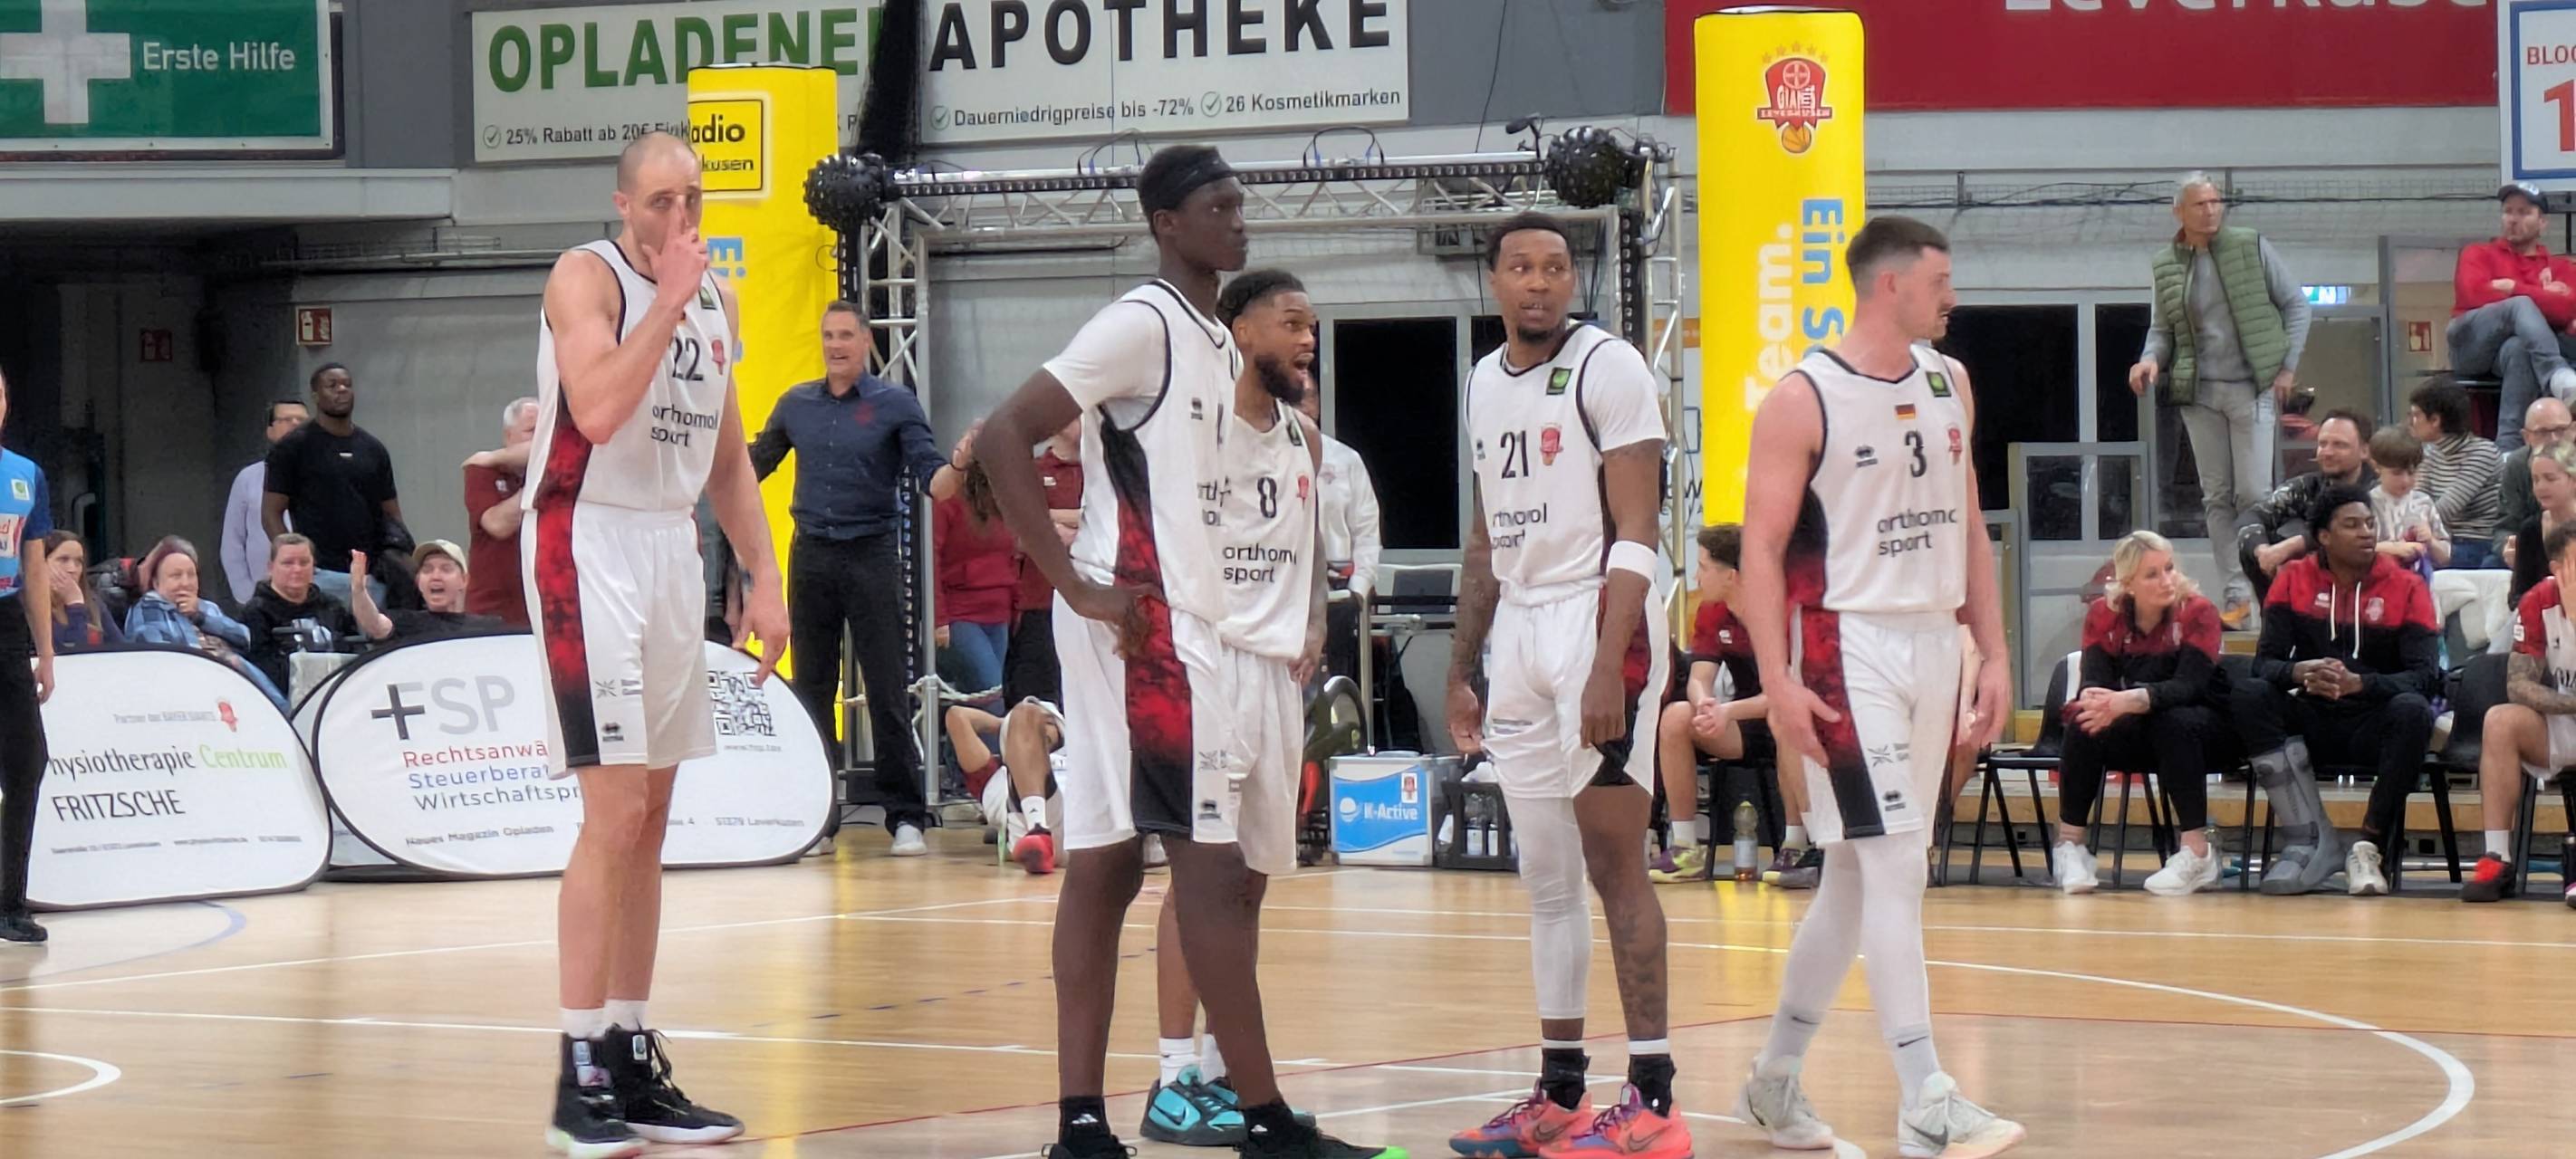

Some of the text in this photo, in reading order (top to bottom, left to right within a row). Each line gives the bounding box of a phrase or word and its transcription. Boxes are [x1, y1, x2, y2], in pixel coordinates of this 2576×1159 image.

[928, 0, 1389, 72] APOTHEKE
[142, 41, 296, 72] Erste Hilfe
[954, 89, 1401, 128] Dauerniedrigpreise bis -72% 26 Kosmetikmarken
[505, 128, 538, 146] 25%
[543, 126, 593, 143] Rabatt
[598, 124, 617, 142] ab
[1802, 197, 1846, 285] Ein
[1499, 430, 1530, 479] 21
[1904, 429, 1927, 478] 3
[1256, 476, 1278, 519] 8
[1222, 542, 1298, 565] orthom
[1878, 531, 1933, 558] sport
[1223, 564, 1275, 585] sport
[198, 743, 289, 770] Centrum
[51, 789, 187, 822] FRITZSCHE
[1363, 802, 1418, 821] K-Active
